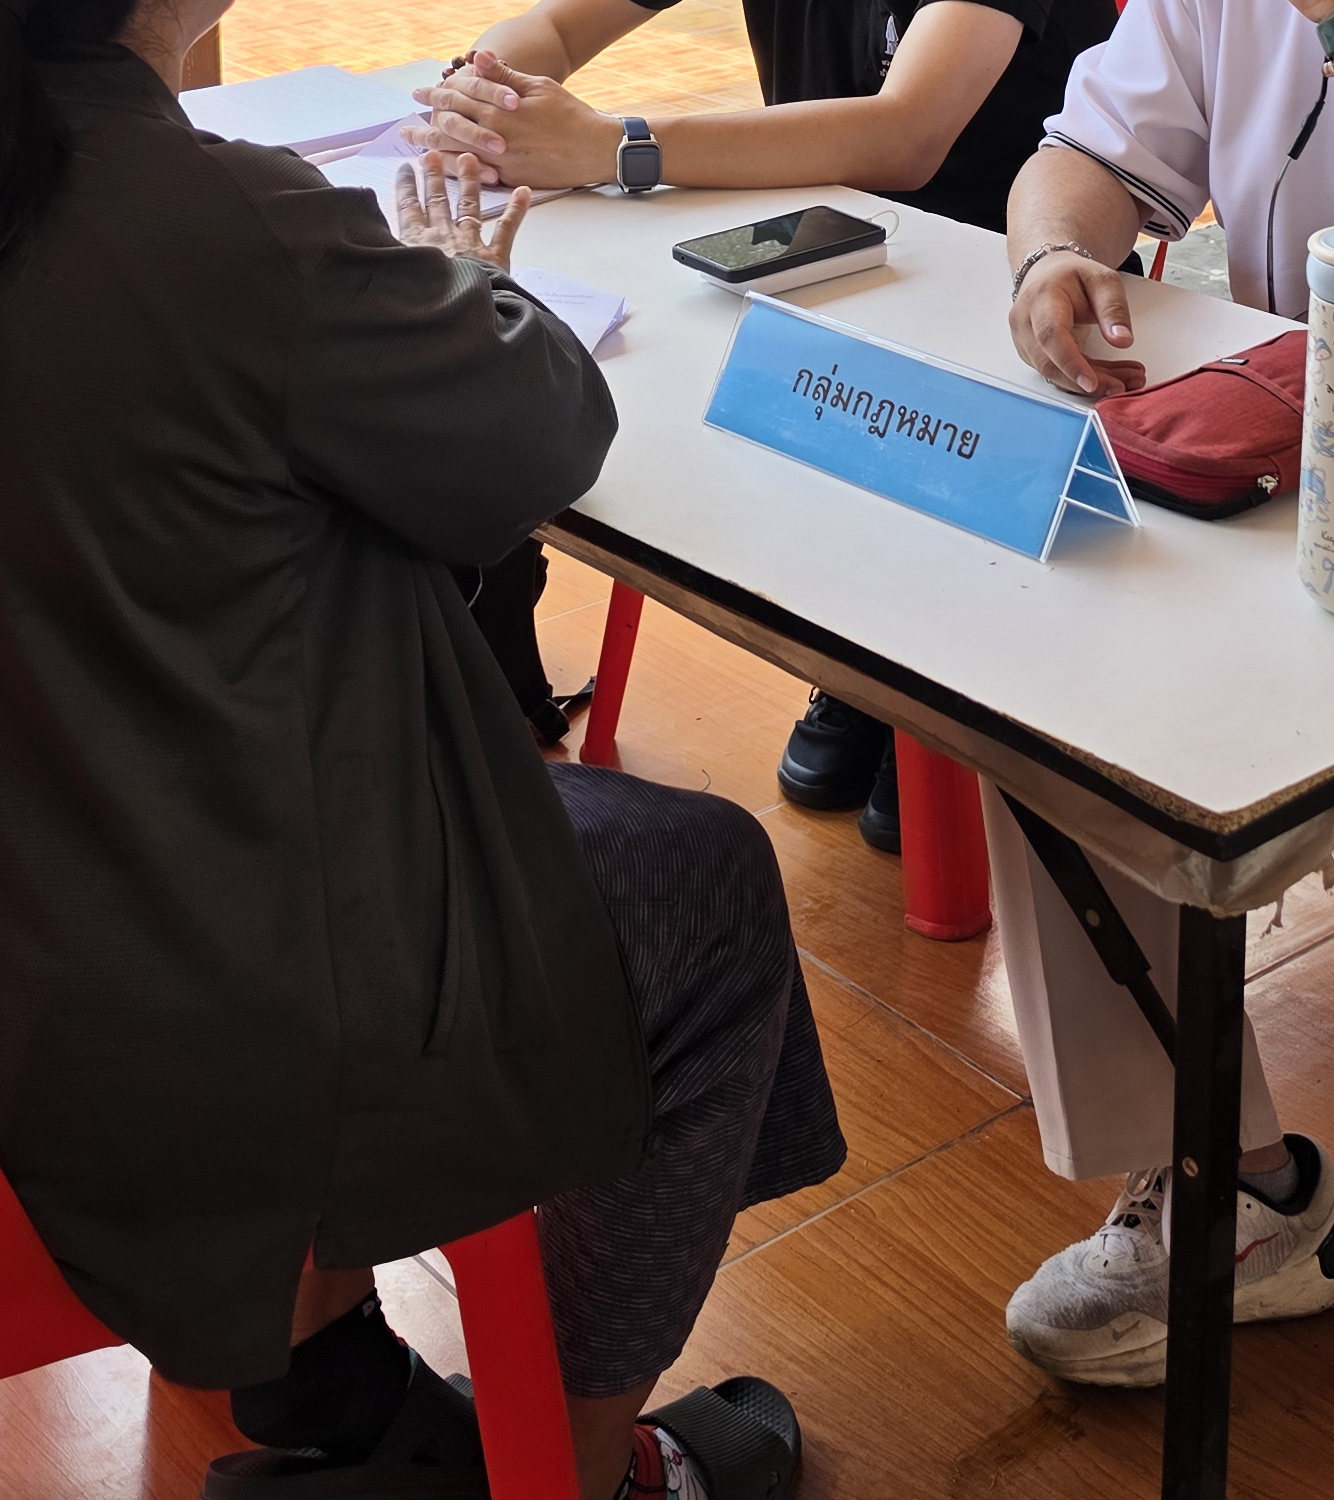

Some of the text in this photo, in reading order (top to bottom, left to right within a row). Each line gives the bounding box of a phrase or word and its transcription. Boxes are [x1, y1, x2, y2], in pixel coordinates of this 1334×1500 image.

[792, 364, 980, 460] กลุ่มกฎหมาย
